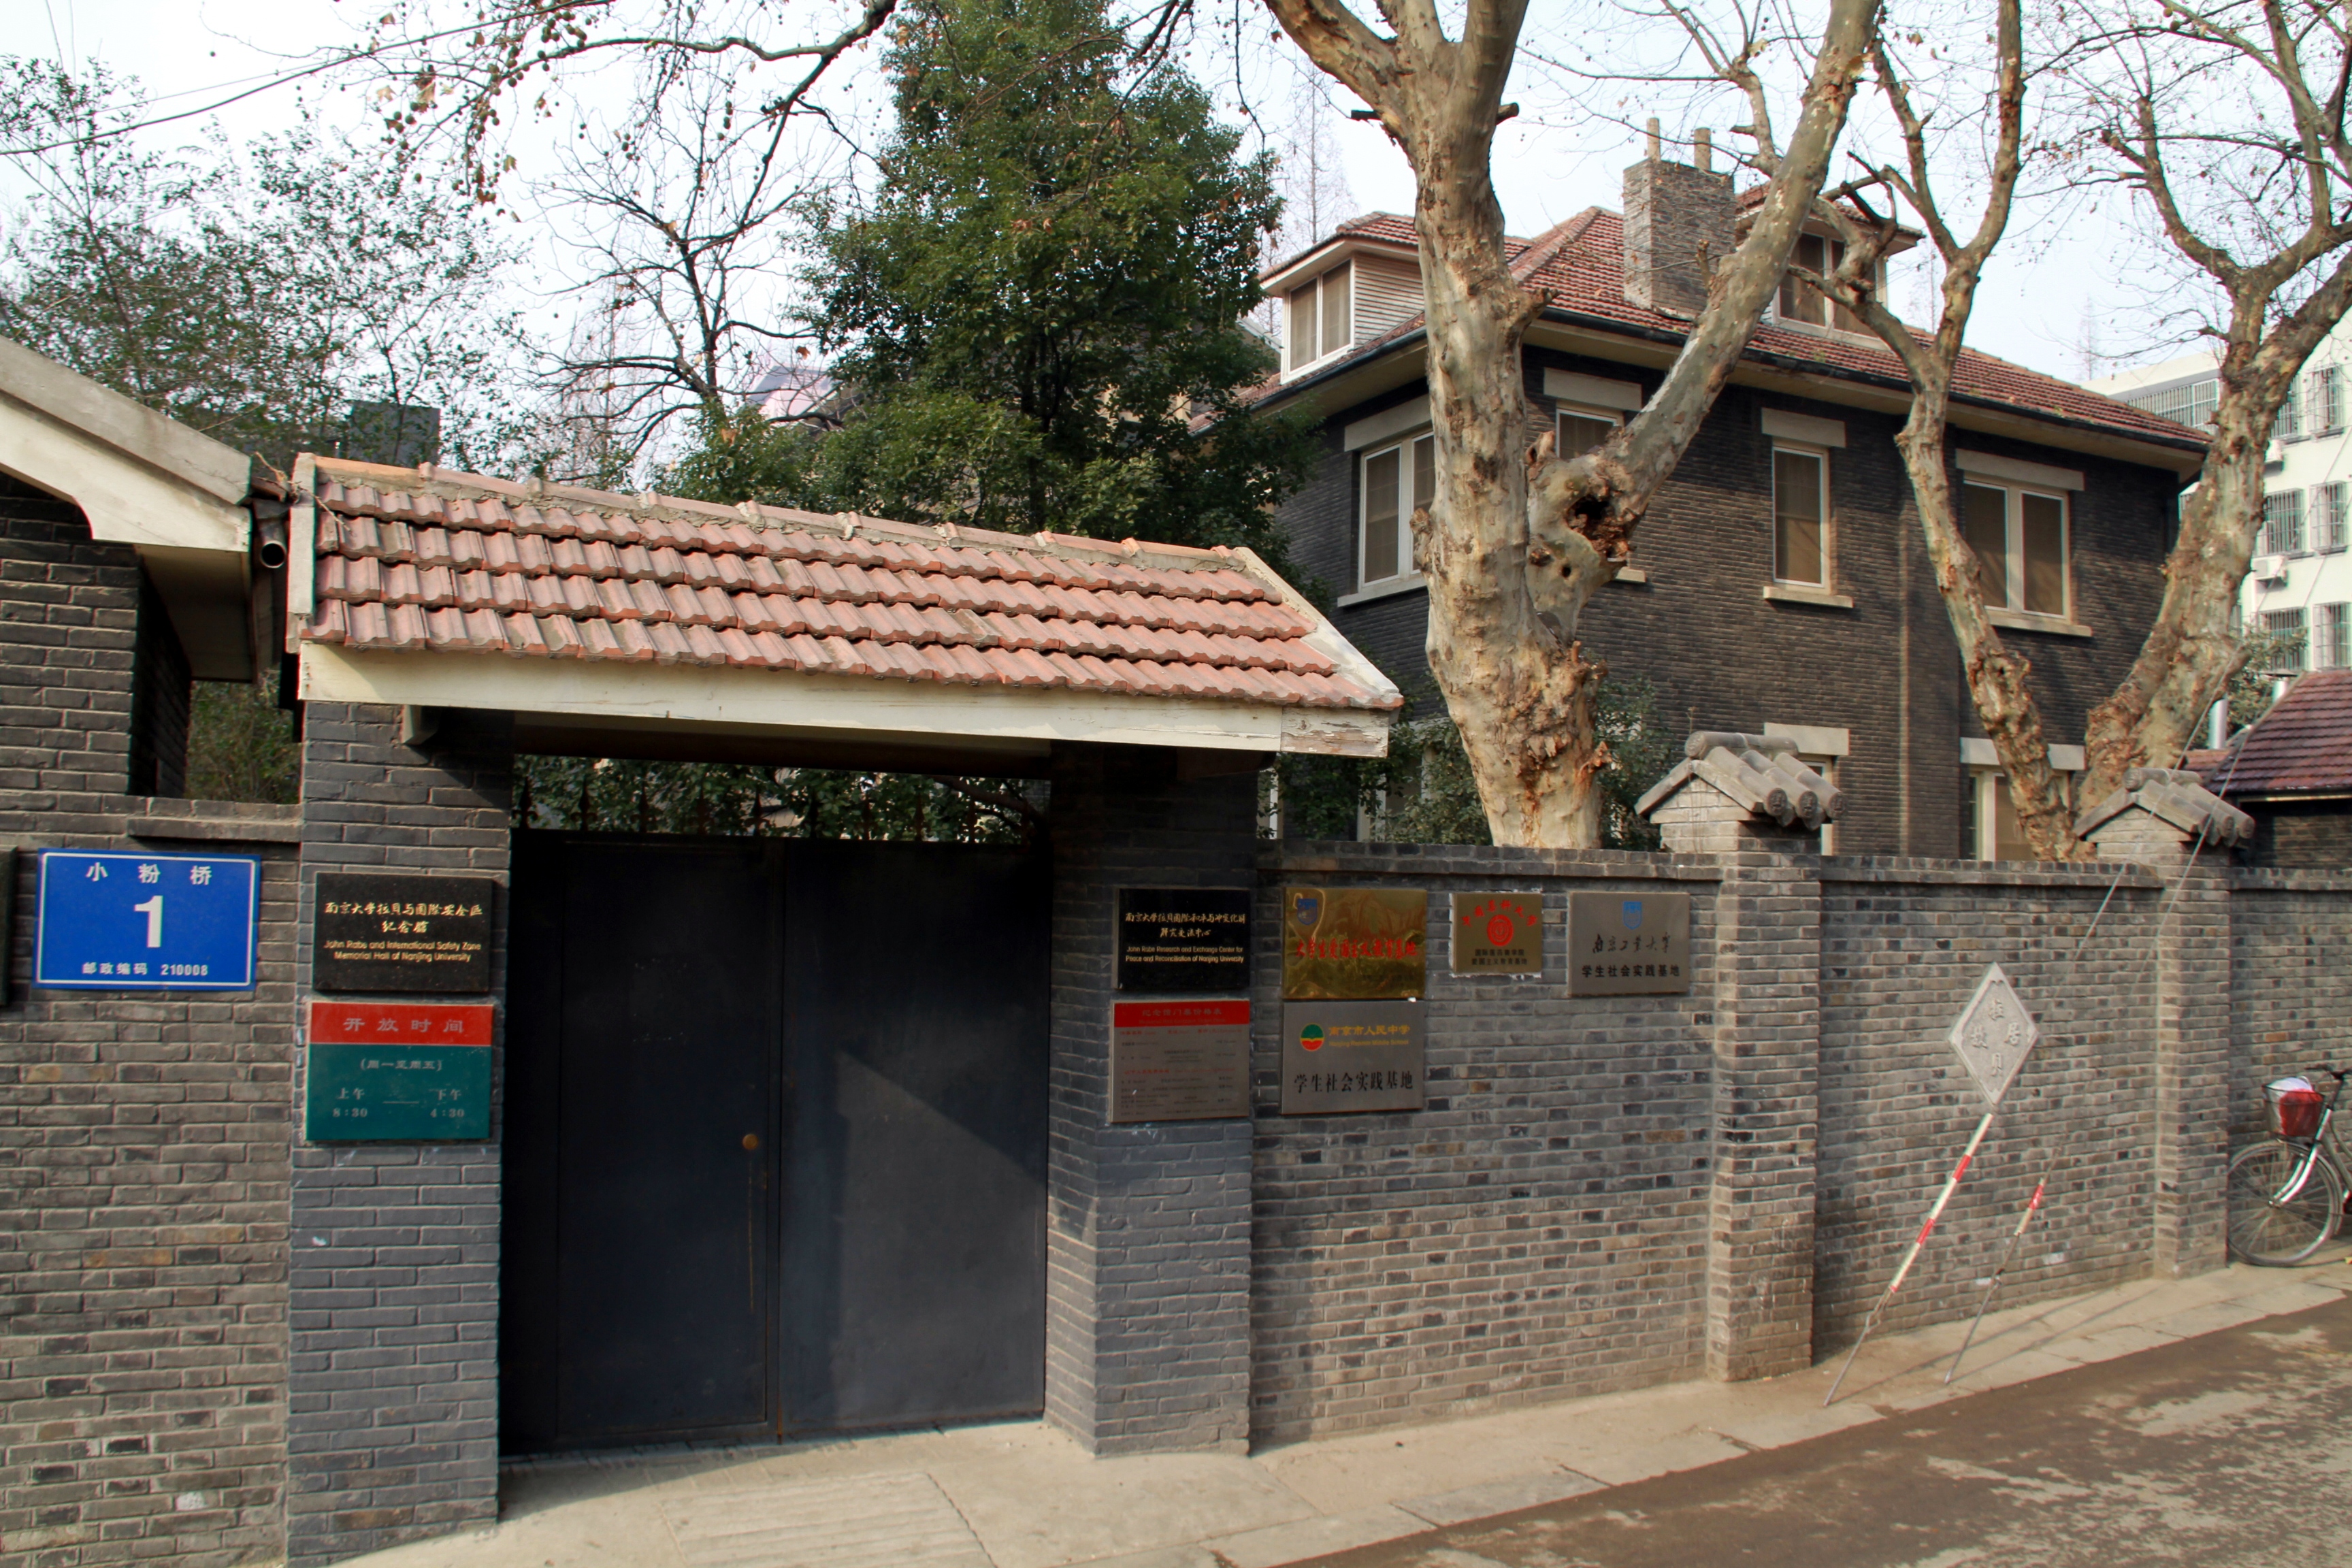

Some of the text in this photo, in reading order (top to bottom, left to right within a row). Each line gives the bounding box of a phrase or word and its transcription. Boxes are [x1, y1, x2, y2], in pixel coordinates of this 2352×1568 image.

[86, 862, 212, 885] 小粉桥
[134, 895, 163, 948] 1
[324, 941, 481, 951] John Rabe and International Safety Zone
[1193, 946, 1218, 954] Exchange
[334, 952, 471, 962] Memorial Hall of Nanjing University
[1198, 956, 1219, 964] Nanjing
[1220, 956, 1244, 964] University
[82, 962, 208, 976] 邮政编码 210008
[1582, 964, 1680, 978] 学生社会实践基地
[343, 1017, 464, 1033] 开放时间
[1294, 1071, 1414, 1094] 学生社会实践基地
[336, 1088, 463, 1100] 上午 下午
